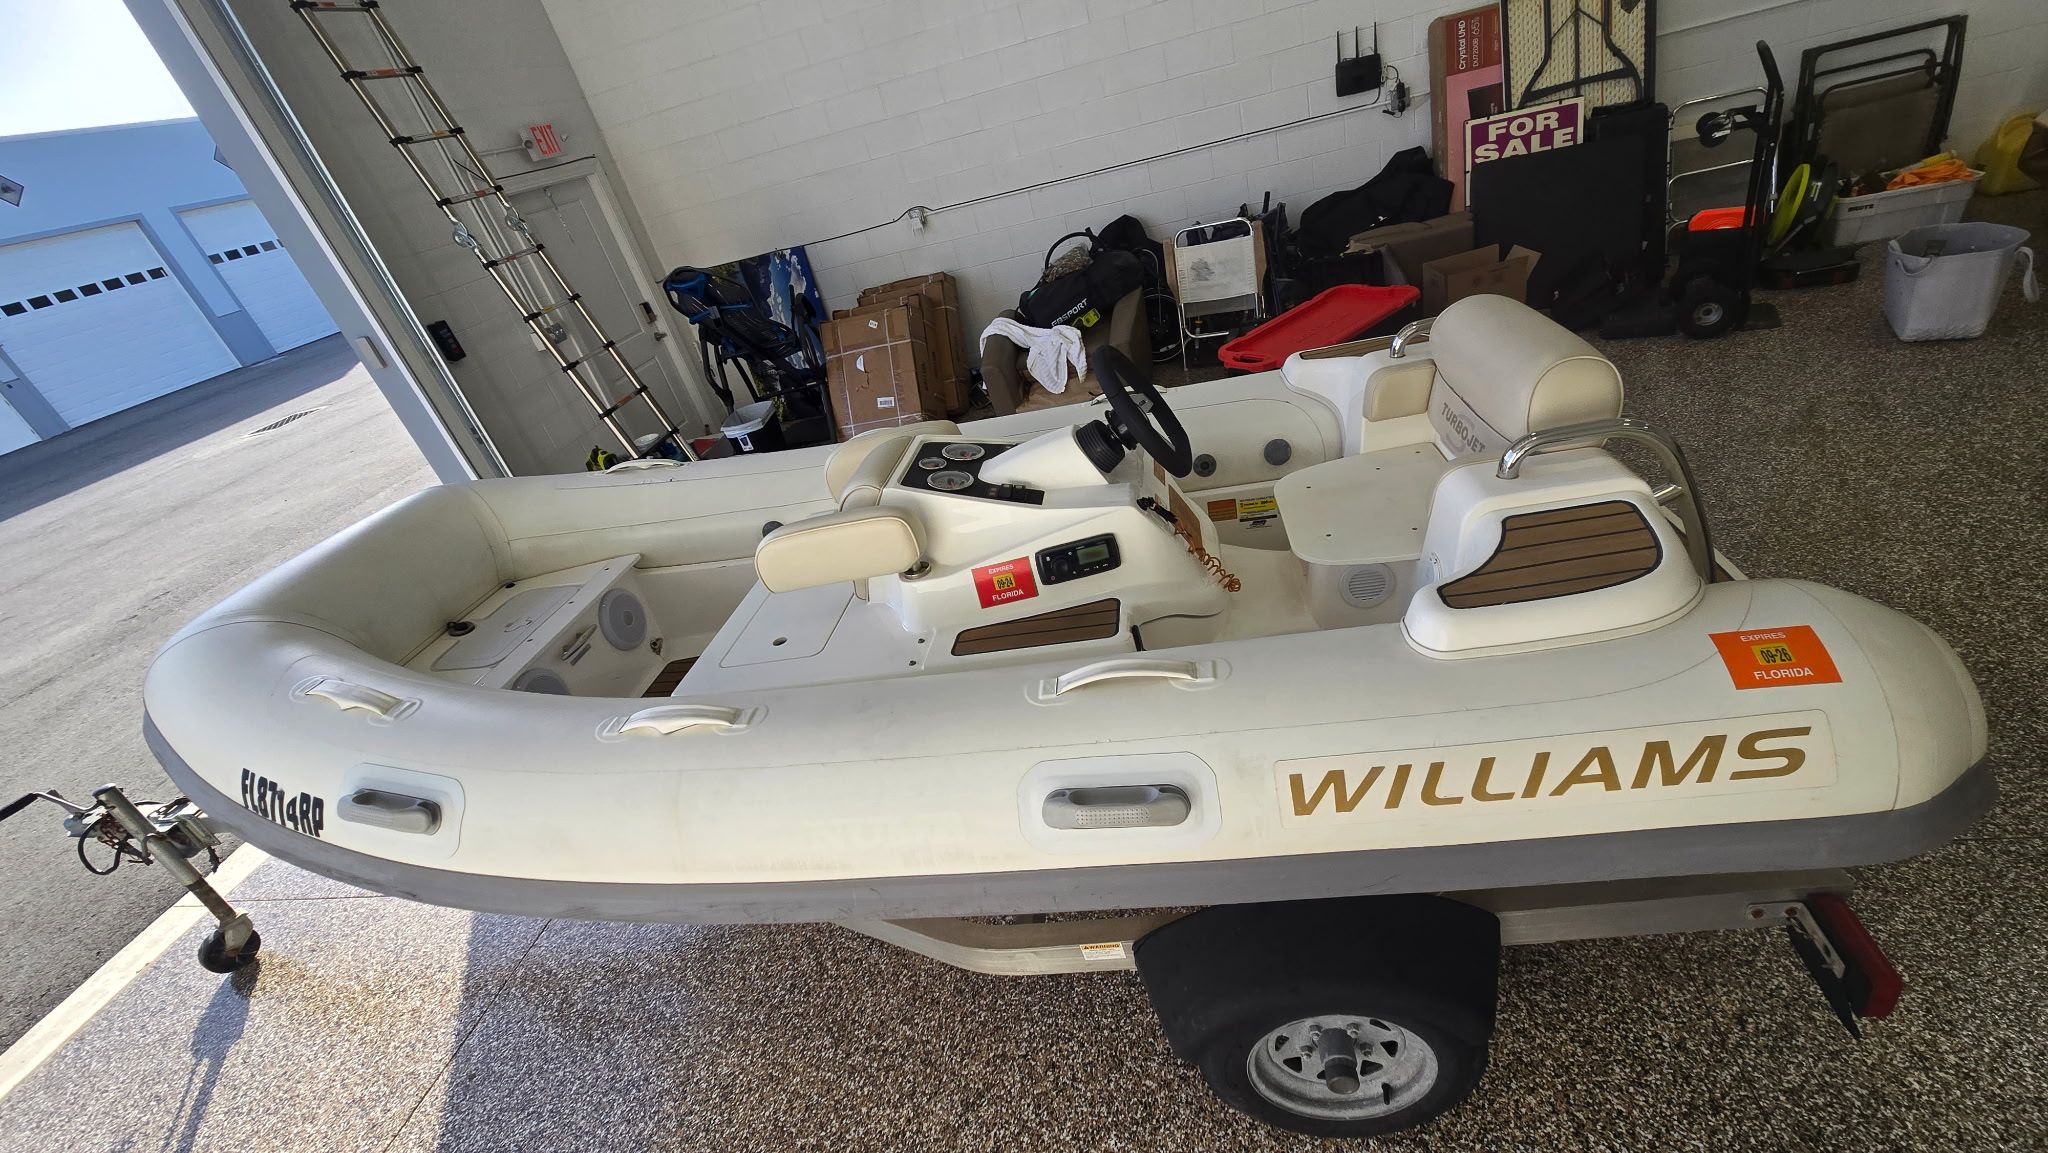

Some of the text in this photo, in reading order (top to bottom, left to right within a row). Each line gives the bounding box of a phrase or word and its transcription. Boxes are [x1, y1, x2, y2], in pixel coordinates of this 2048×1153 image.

[1458, 20, 1467, 70] Crystal UHD
[1488, 112, 1559, 142] FOR
[530, 124, 561, 155] EXIT
[1474, 127, 1574, 164] SALE
[1441, 402, 1486, 453] TURBOJET
[988, 564, 1014, 575] EXPIRES
[996, 577, 1014, 590] 09-24
[992, 589, 1024, 602] FLORIDA
[1740, 632, 1786, 642] EXPIRES
[1760, 647, 1792, 664] 09-26
[1753, 667, 1814, 681] FLORIDA
[1288, 726, 1812, 817] WILLIAMS
